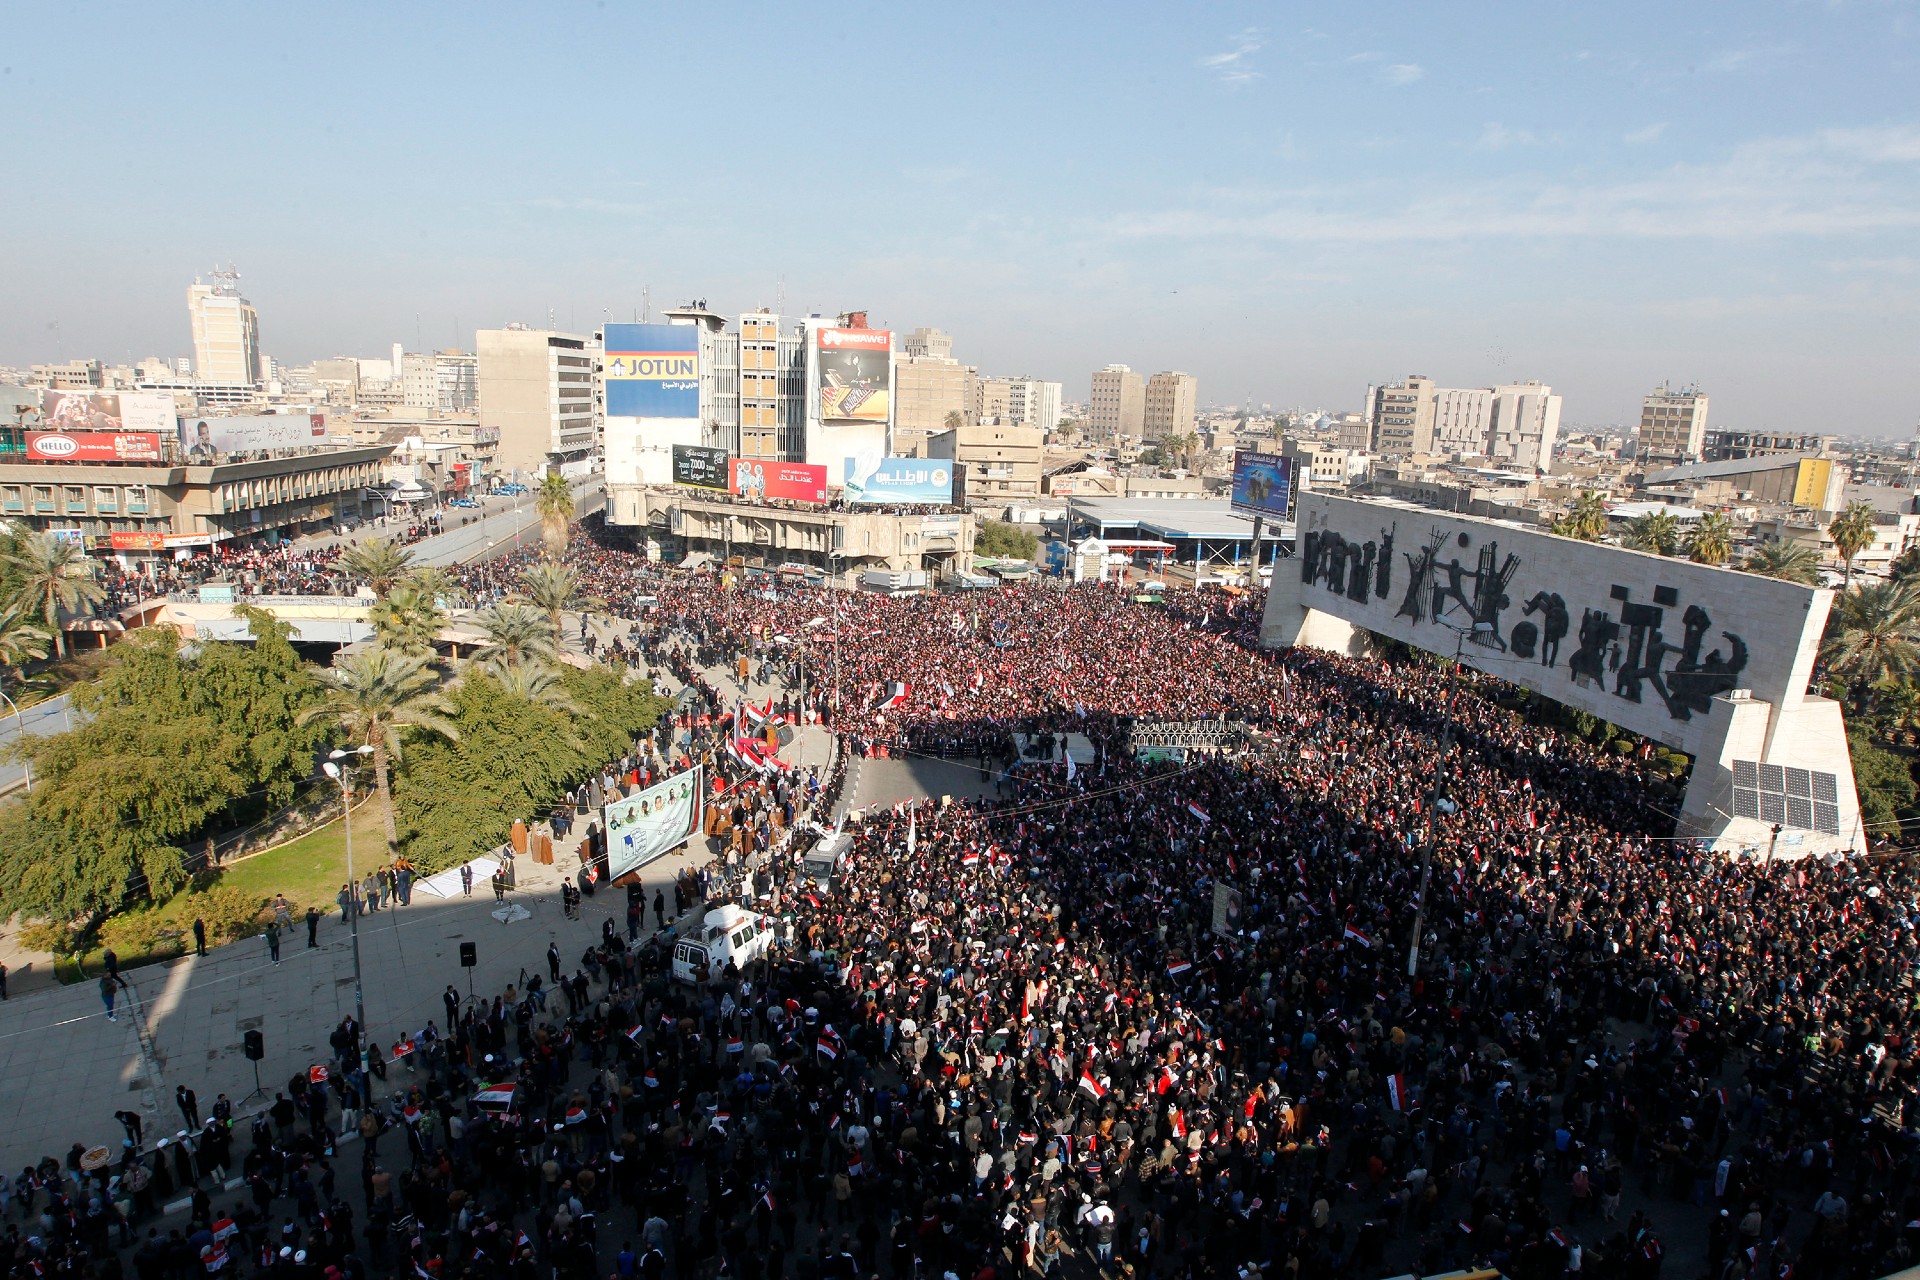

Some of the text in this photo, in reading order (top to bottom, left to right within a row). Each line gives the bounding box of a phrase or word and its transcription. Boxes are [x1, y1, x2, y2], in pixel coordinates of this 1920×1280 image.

[845, 333, 887, 344] HUAWEI
[629, 359, 693, 376] JOTUN
[41, 442, 71, 450] HELLO
[690, 458, 705, 470] 7,000
[778, 473, 813, 484] عندنا الحل
[875, 469, 928, 484] الاطلس
